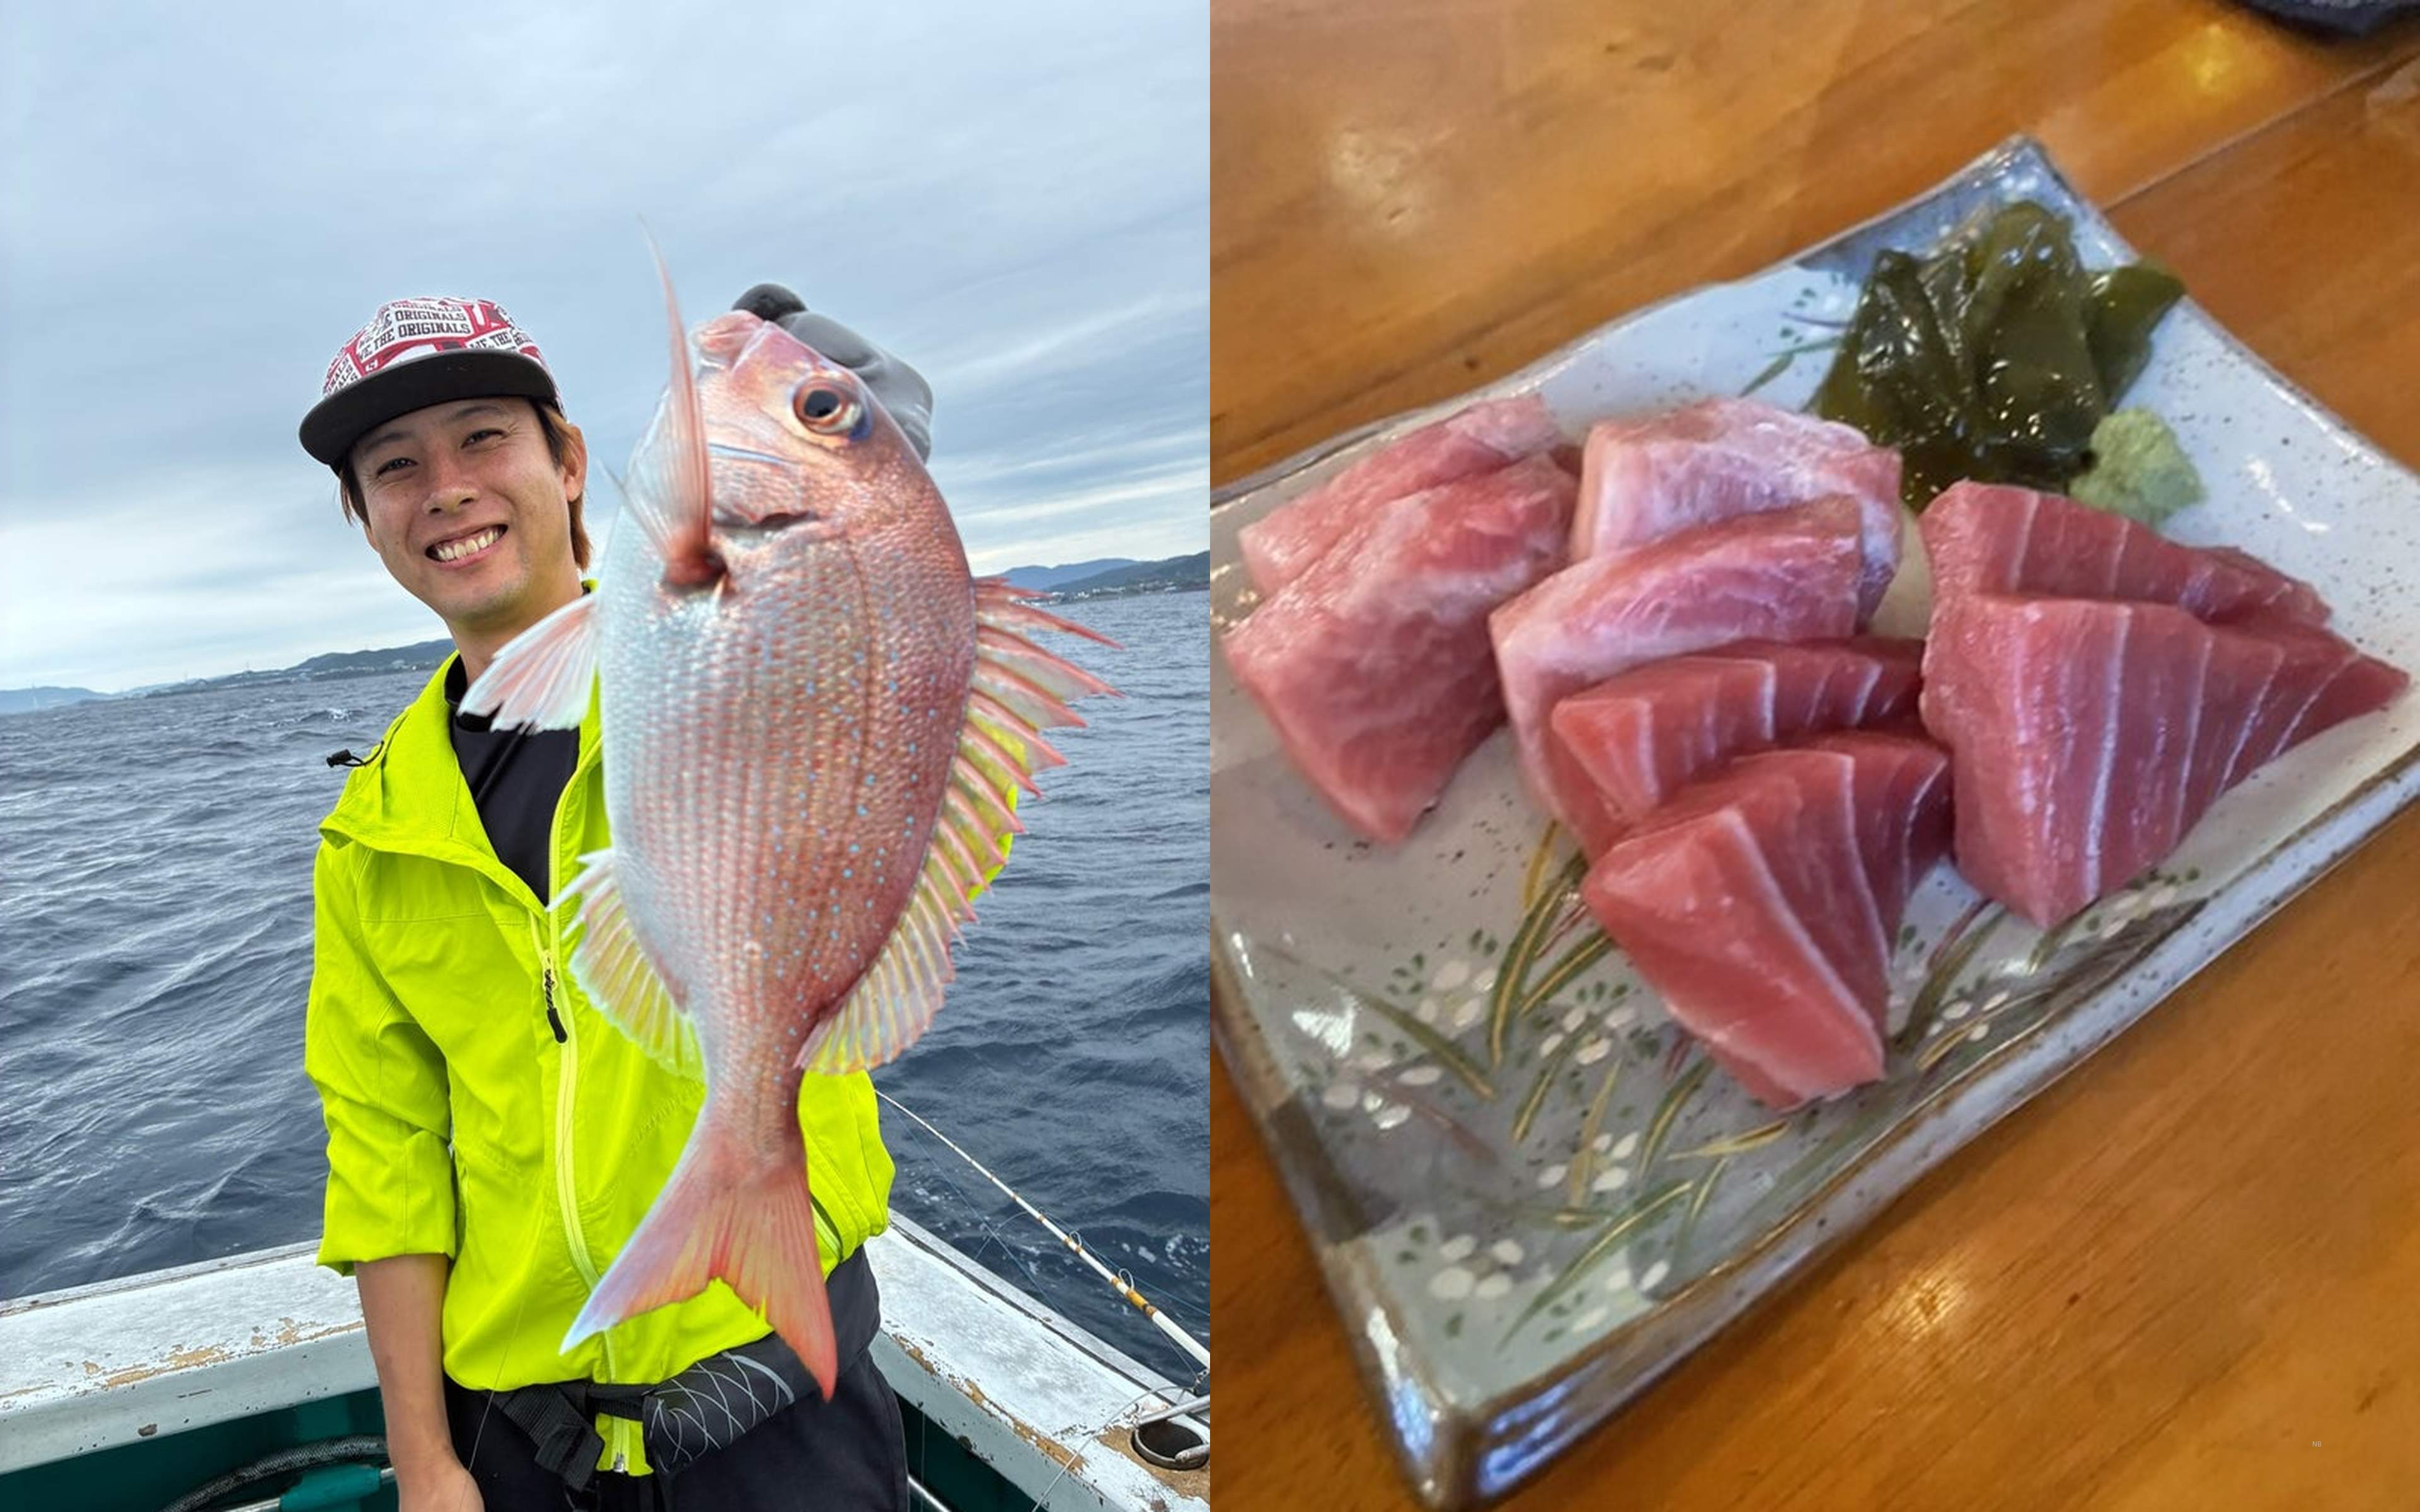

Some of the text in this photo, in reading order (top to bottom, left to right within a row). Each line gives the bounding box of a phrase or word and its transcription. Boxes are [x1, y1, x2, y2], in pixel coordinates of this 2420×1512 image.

[395, 309, 467, 322] ORIGINALS
[374, 327, 395, 350] THE
[398, 321, 471, 338] ORIGINALS
